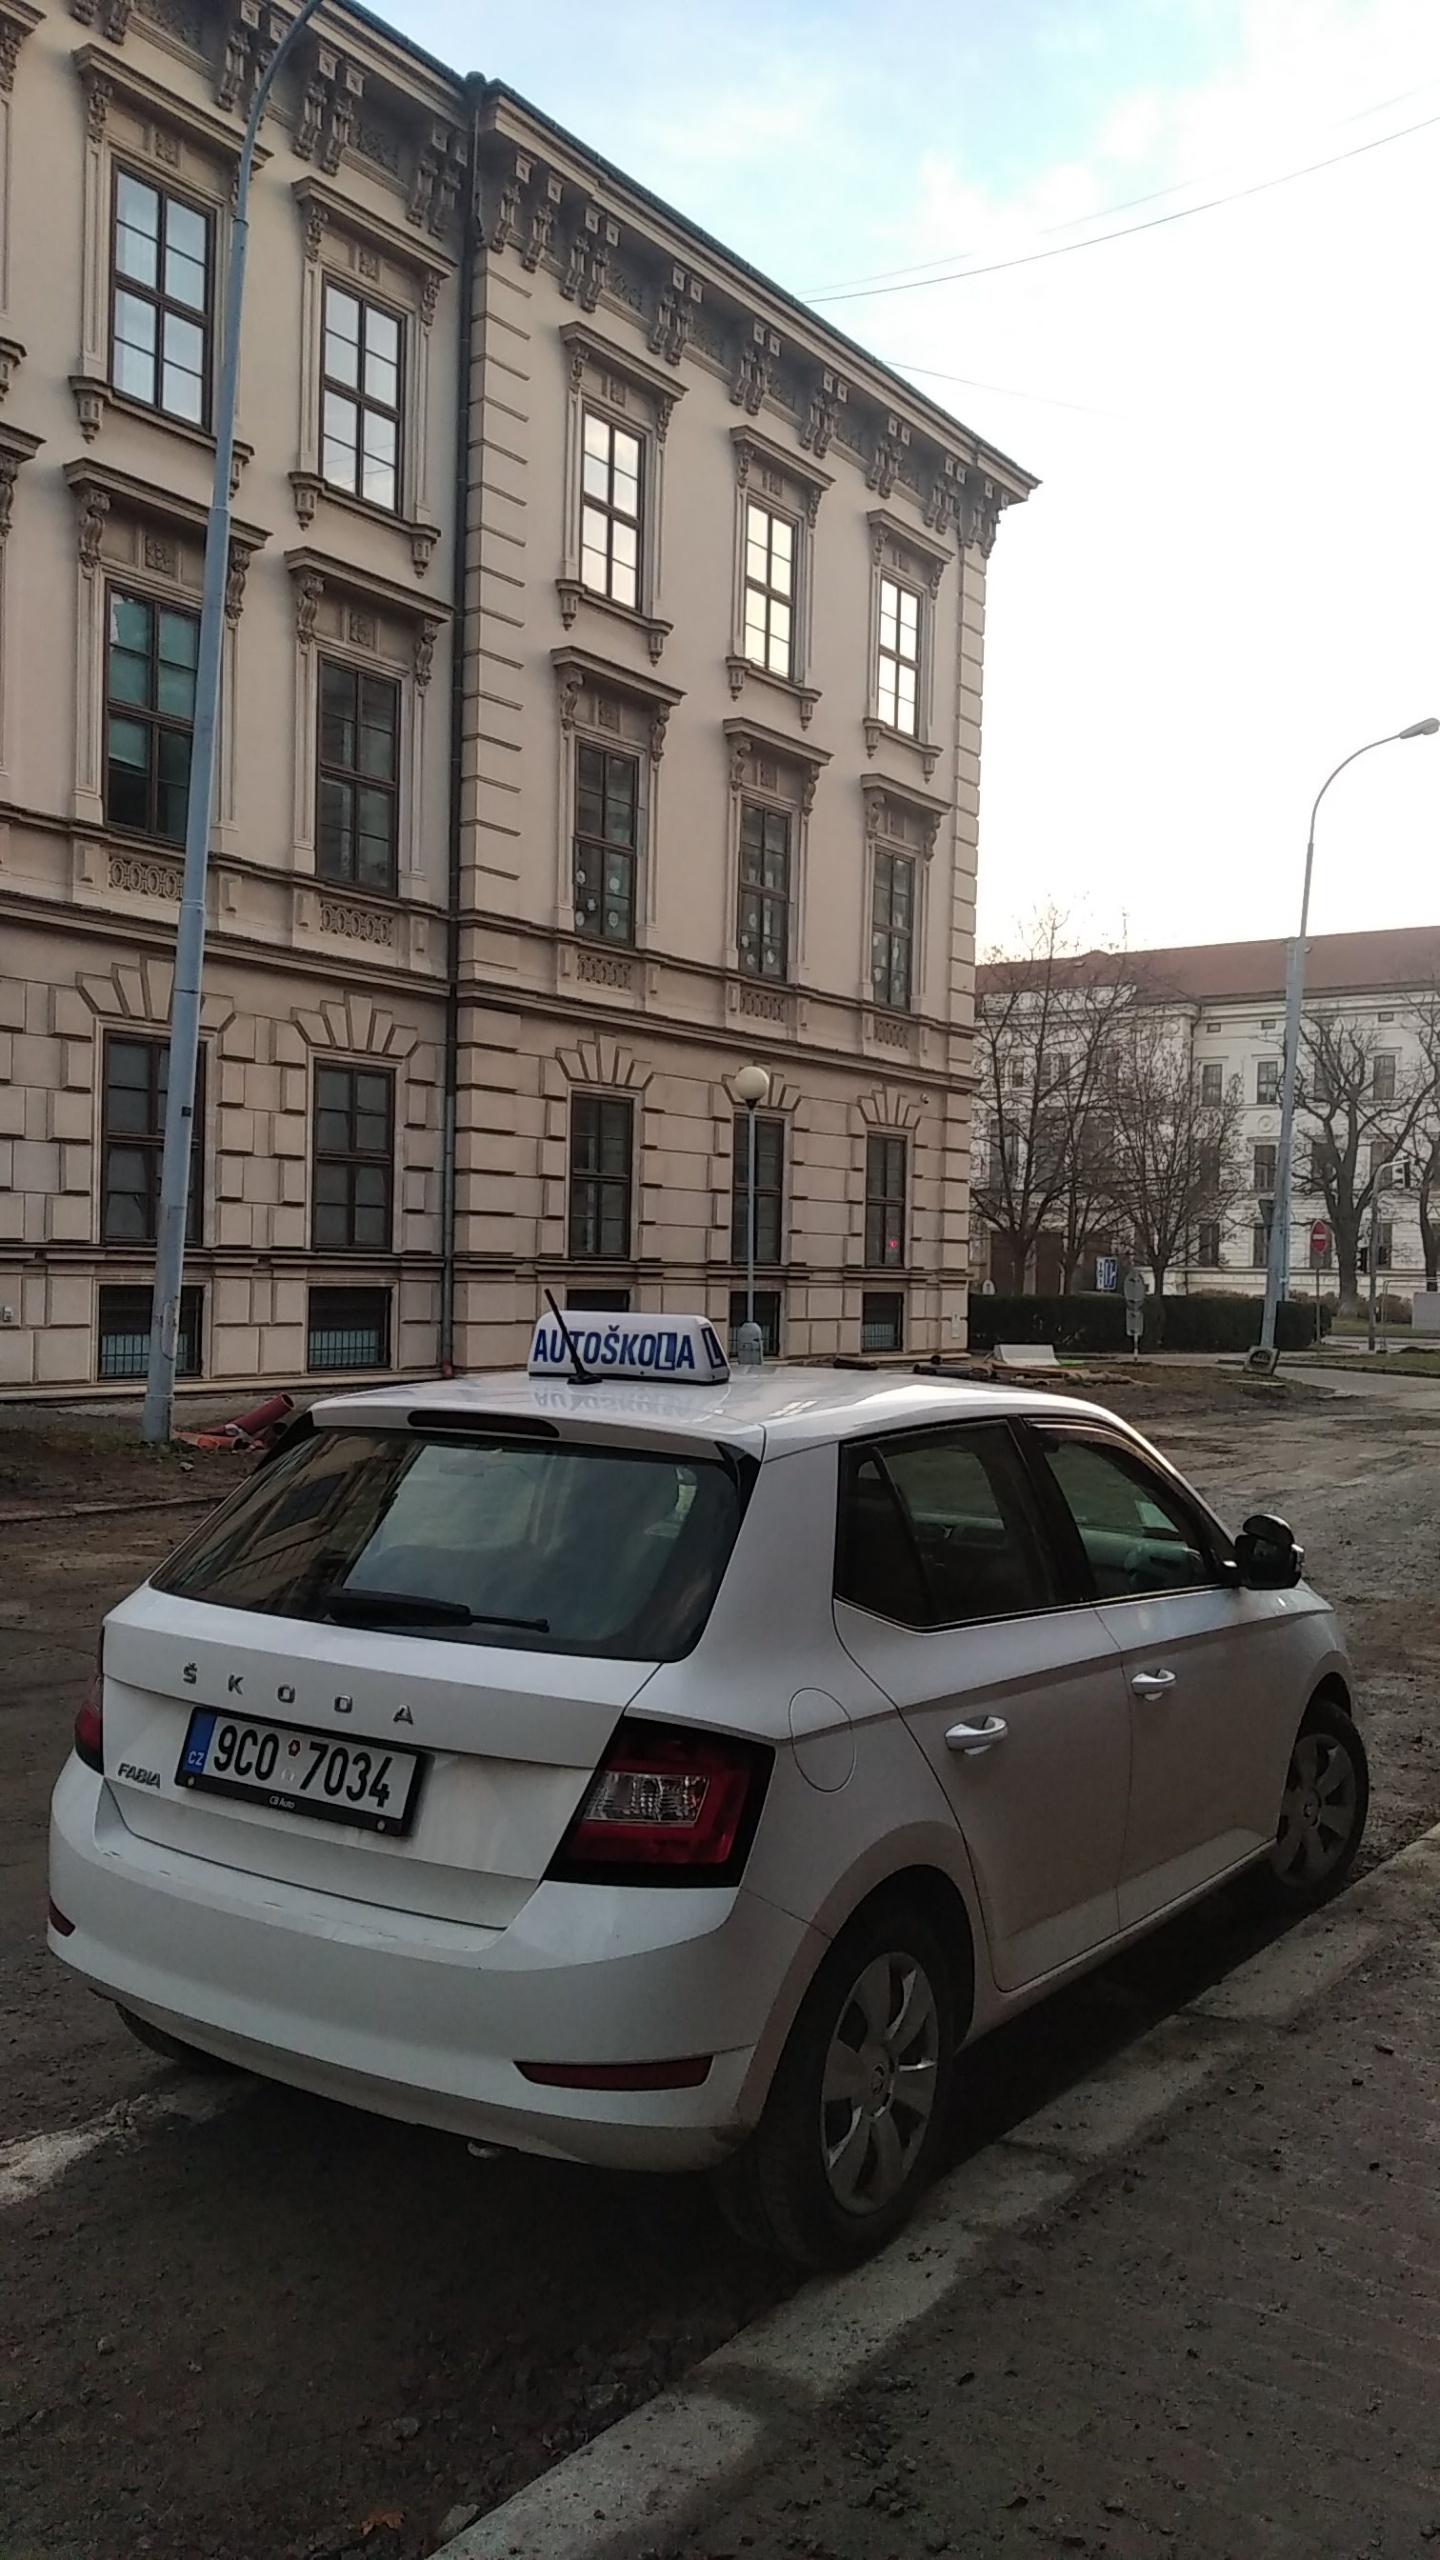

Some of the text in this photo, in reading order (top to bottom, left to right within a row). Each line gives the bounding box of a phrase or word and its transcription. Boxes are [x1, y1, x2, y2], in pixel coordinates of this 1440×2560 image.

[533, 1325, 695, 1370] AUTOŠKOLA
[183, 1662, 415, 1725] ŠKODA
[118, 1763, 161, 1789] FABIA
[188, 1750, 204, 1766] CZ
[214, 1725, 393, 1808] 9C0 7034
